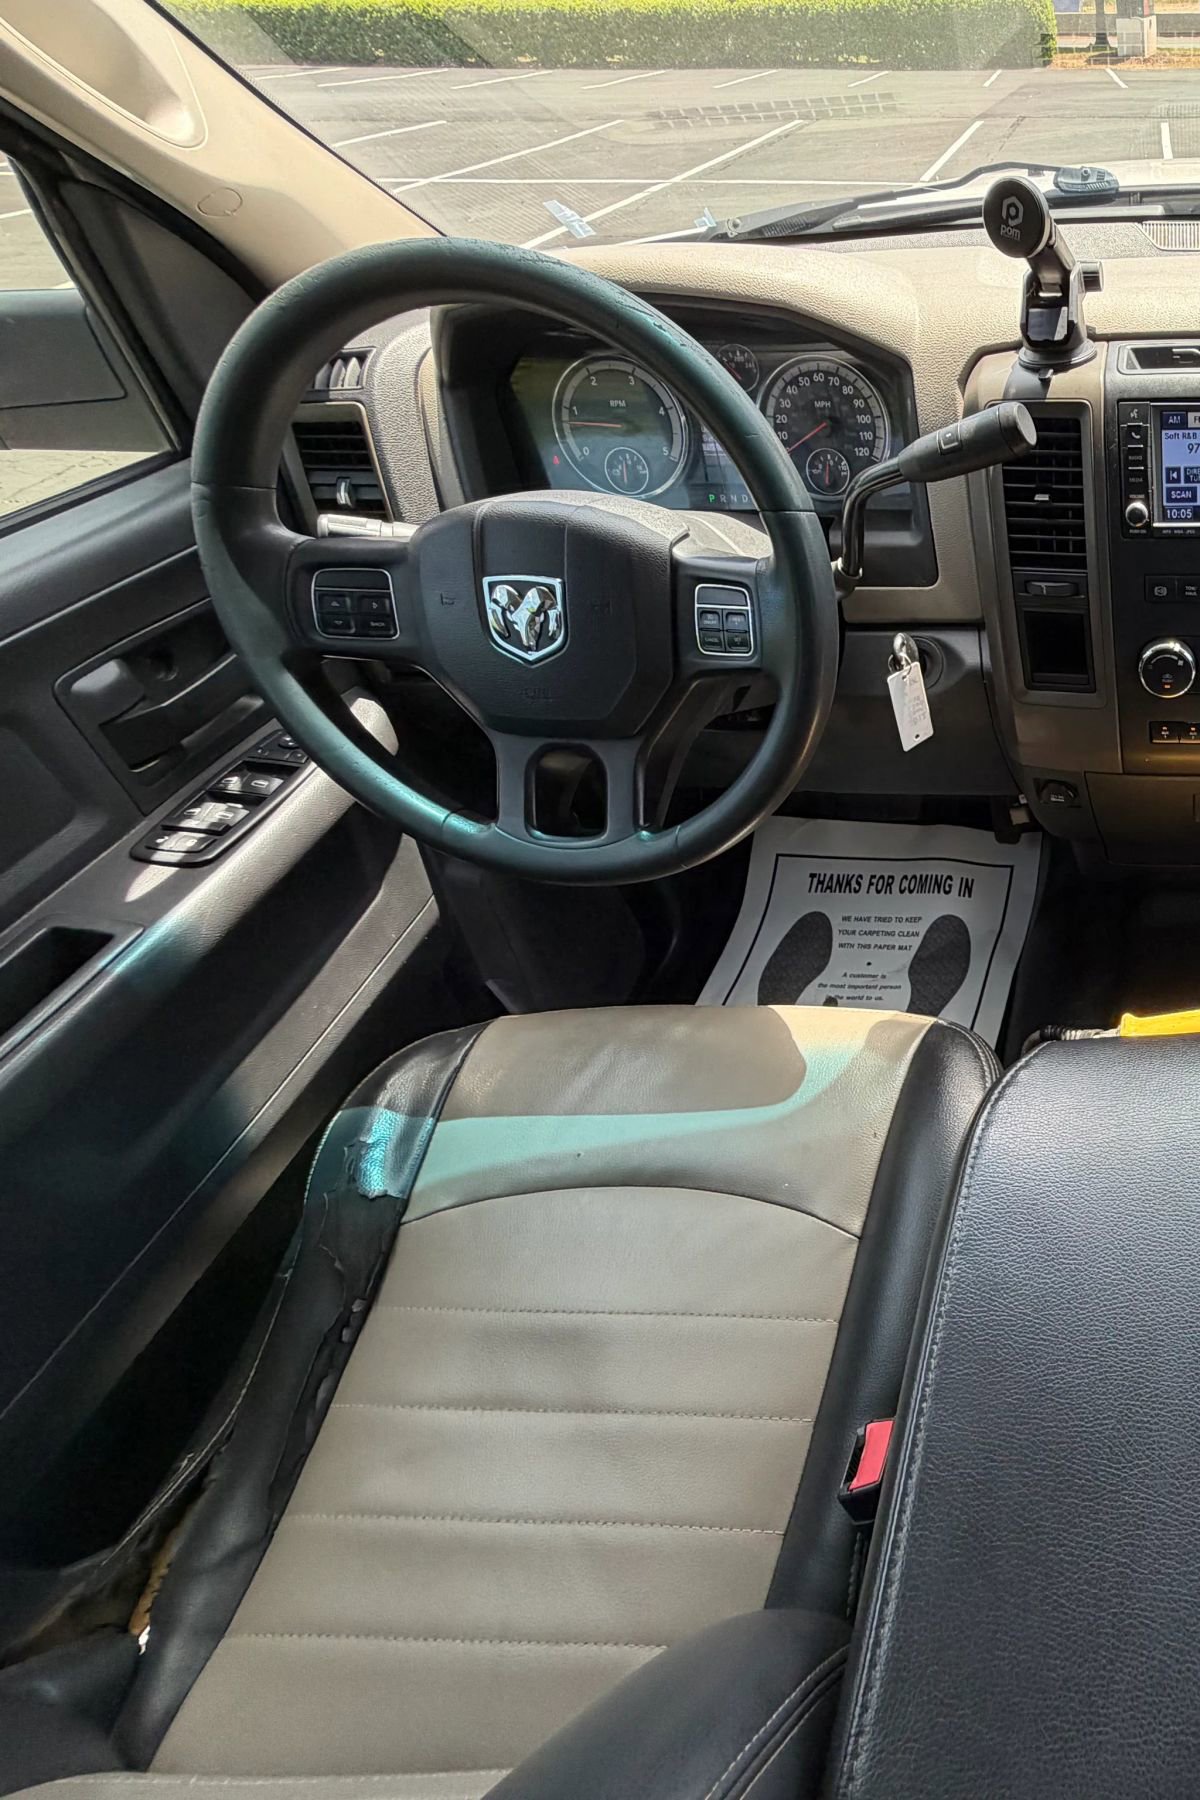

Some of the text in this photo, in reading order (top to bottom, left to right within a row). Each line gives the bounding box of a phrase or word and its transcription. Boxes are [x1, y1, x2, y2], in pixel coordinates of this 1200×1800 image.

[590, 376, 598, 386] 2
[628, 376, 635, 386] 3
[798, 377, 810, 386] 50
[813, 373, 825, 382] 60
[828, 377, 840, 386] 70
[786, 385, 798, 394] 40
[842, 386, 854, 394] 80
[610, 400, 626, 408] RPM
[780, 399, 791, 408] 30
[814, 400, 831, 408] MPH
[853, 399, 864, 408] 90
[572, 406, 578, 415] 1
[659, 407, 665, 416] 4
[775, 414, 788, 424] 20
[856, 414, 872, 424] 100
[1168, 416, 1180, 424] AM
[778, 432, 788, 440] 10
[859, 432, 873, 440] 110
[1164, 432, 1197, 440] Soft R&B
[583, 447, 590, 455] 0
[663, 447, 668, 456] 5
[854, 447, 870, 456] 120
[709, 494, 748, 503] P R N D
[1167, 509, 1192, 519] 10:05
[808, 873, 975, 898] THANKS FOR COMING IN
